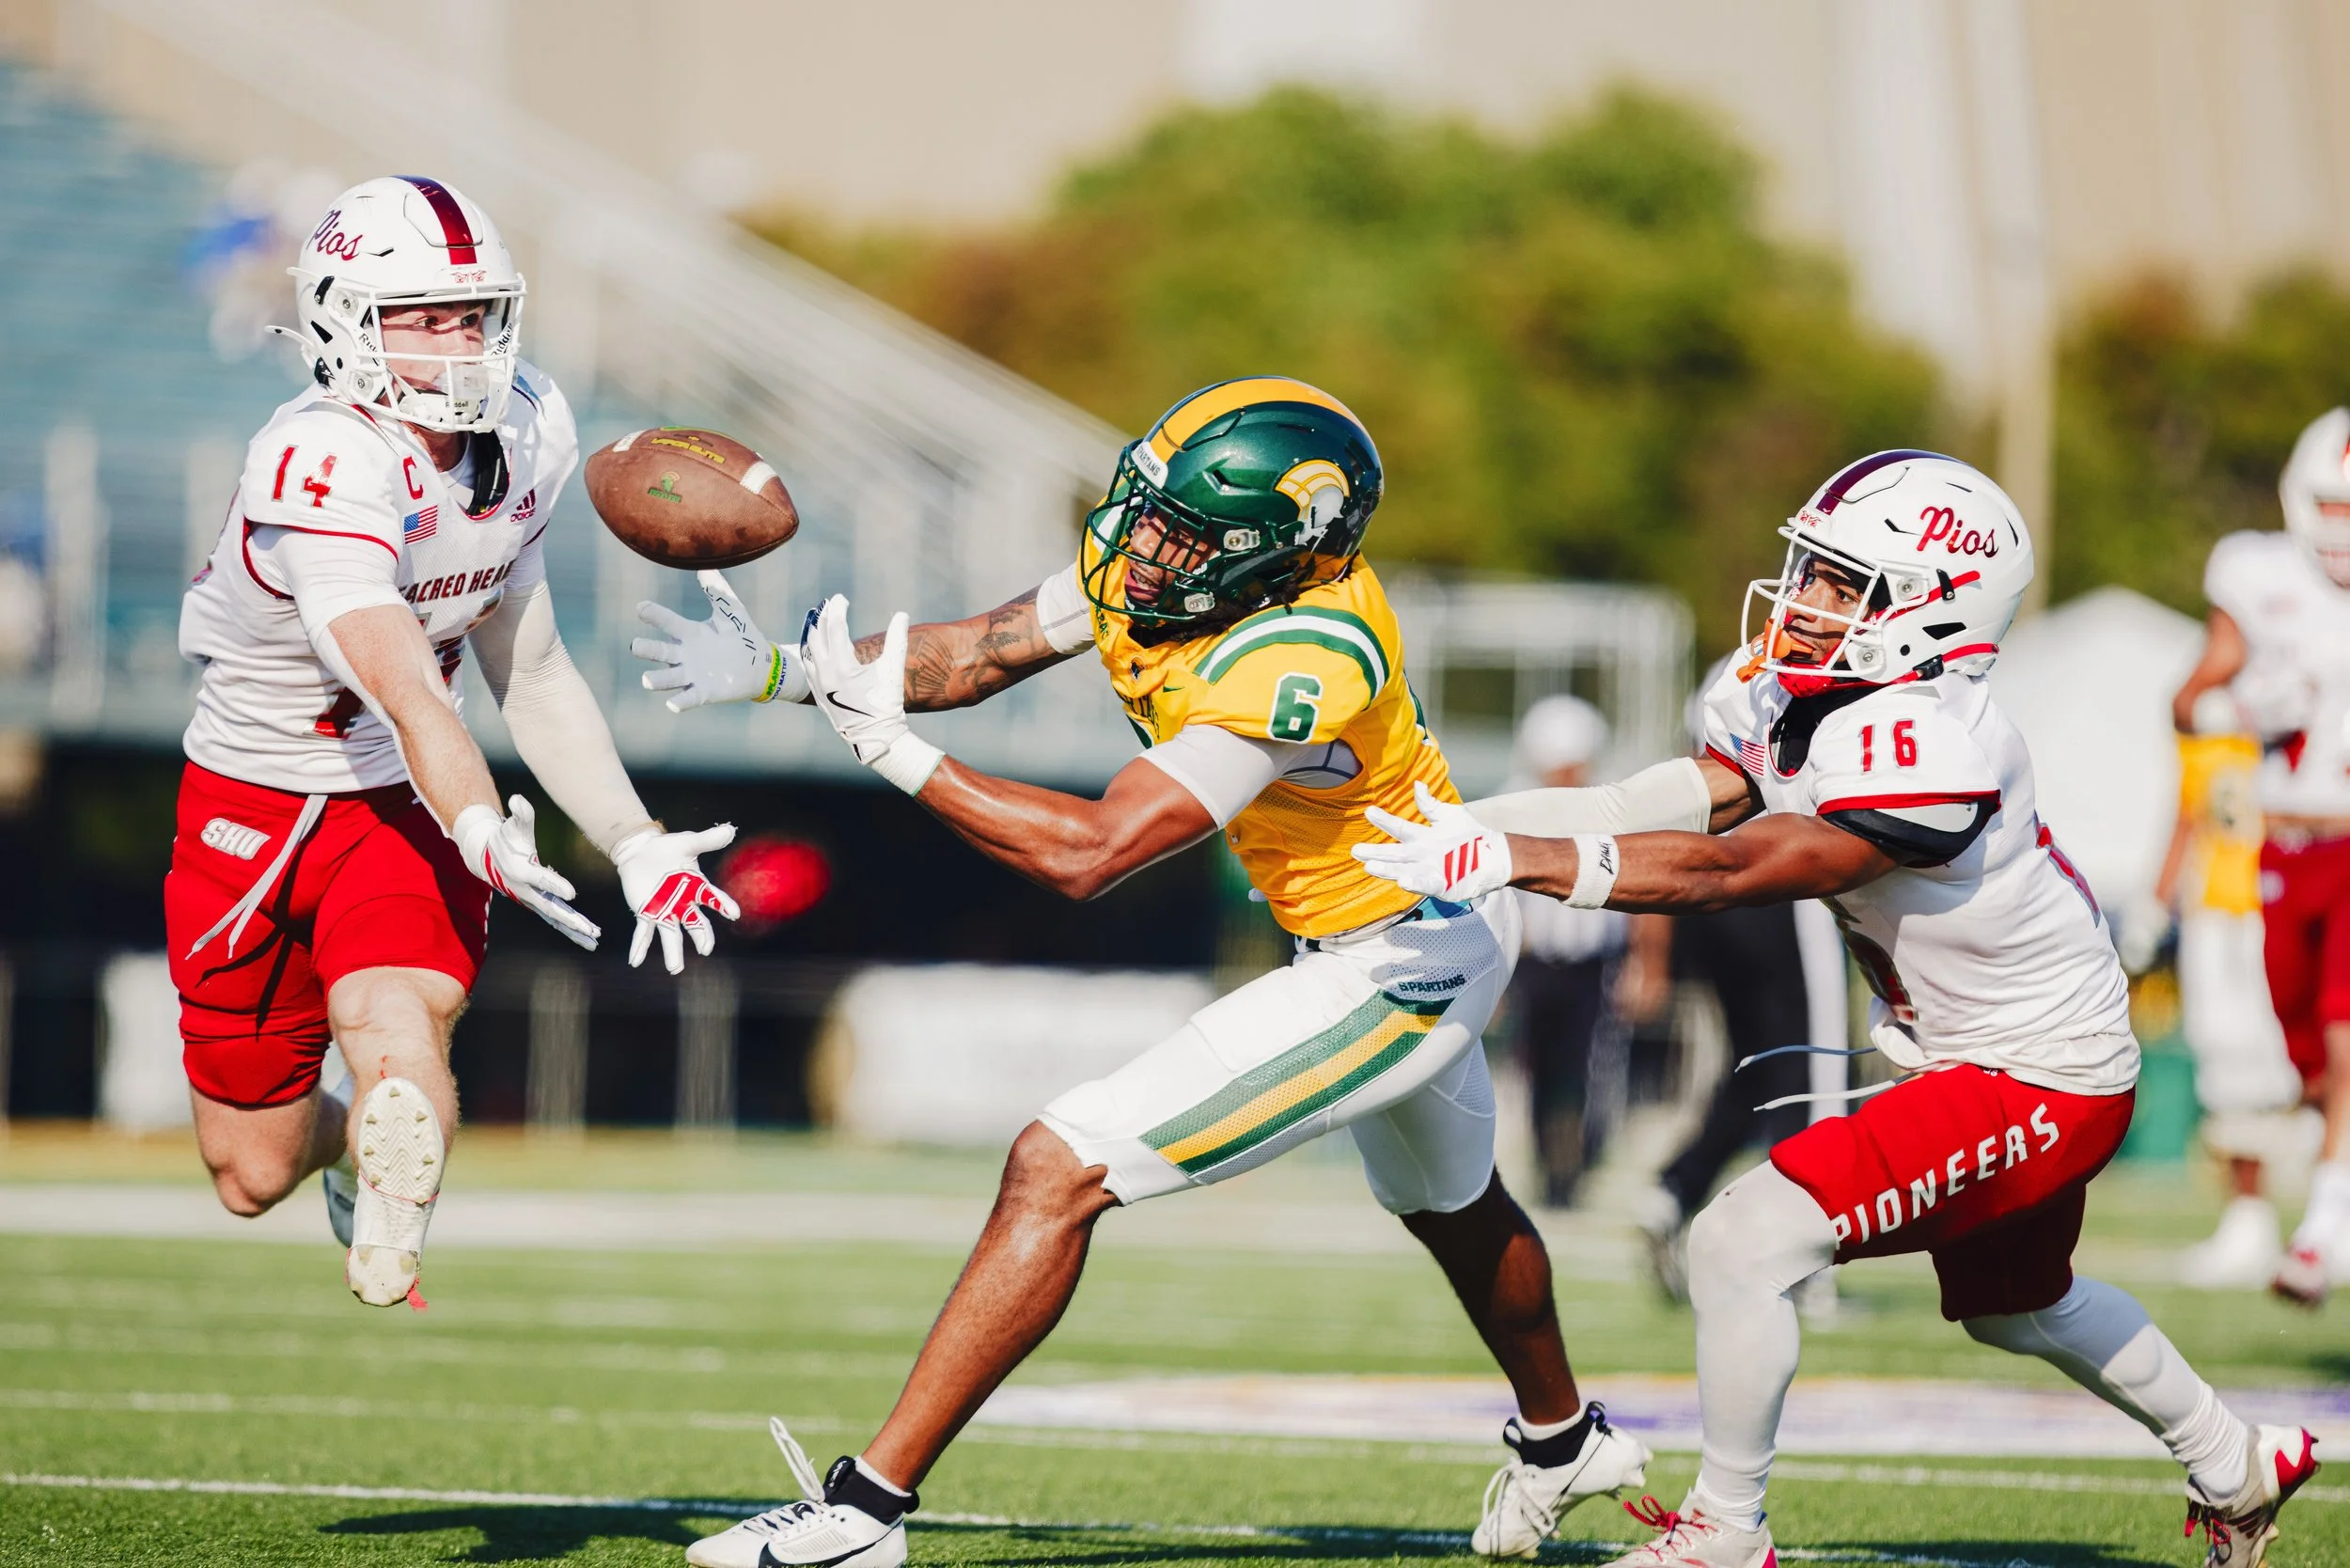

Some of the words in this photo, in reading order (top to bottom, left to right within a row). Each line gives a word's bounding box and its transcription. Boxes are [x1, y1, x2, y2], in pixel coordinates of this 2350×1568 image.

[306, 209, 364, 261] Pios
[272, 444, 338, 509] 14
[402, 456, 424, 500] C
[1917, 506, 1999, 558] Pios
[1266, 671, 1324, 745] 6
[1858, 717, 1919, 775] 16
[200, 817, 272, 860] SHU
[1398, 974, 1466, 993] SPARTANS
[1830, 1102, 2060, 1250] PIONEERS
